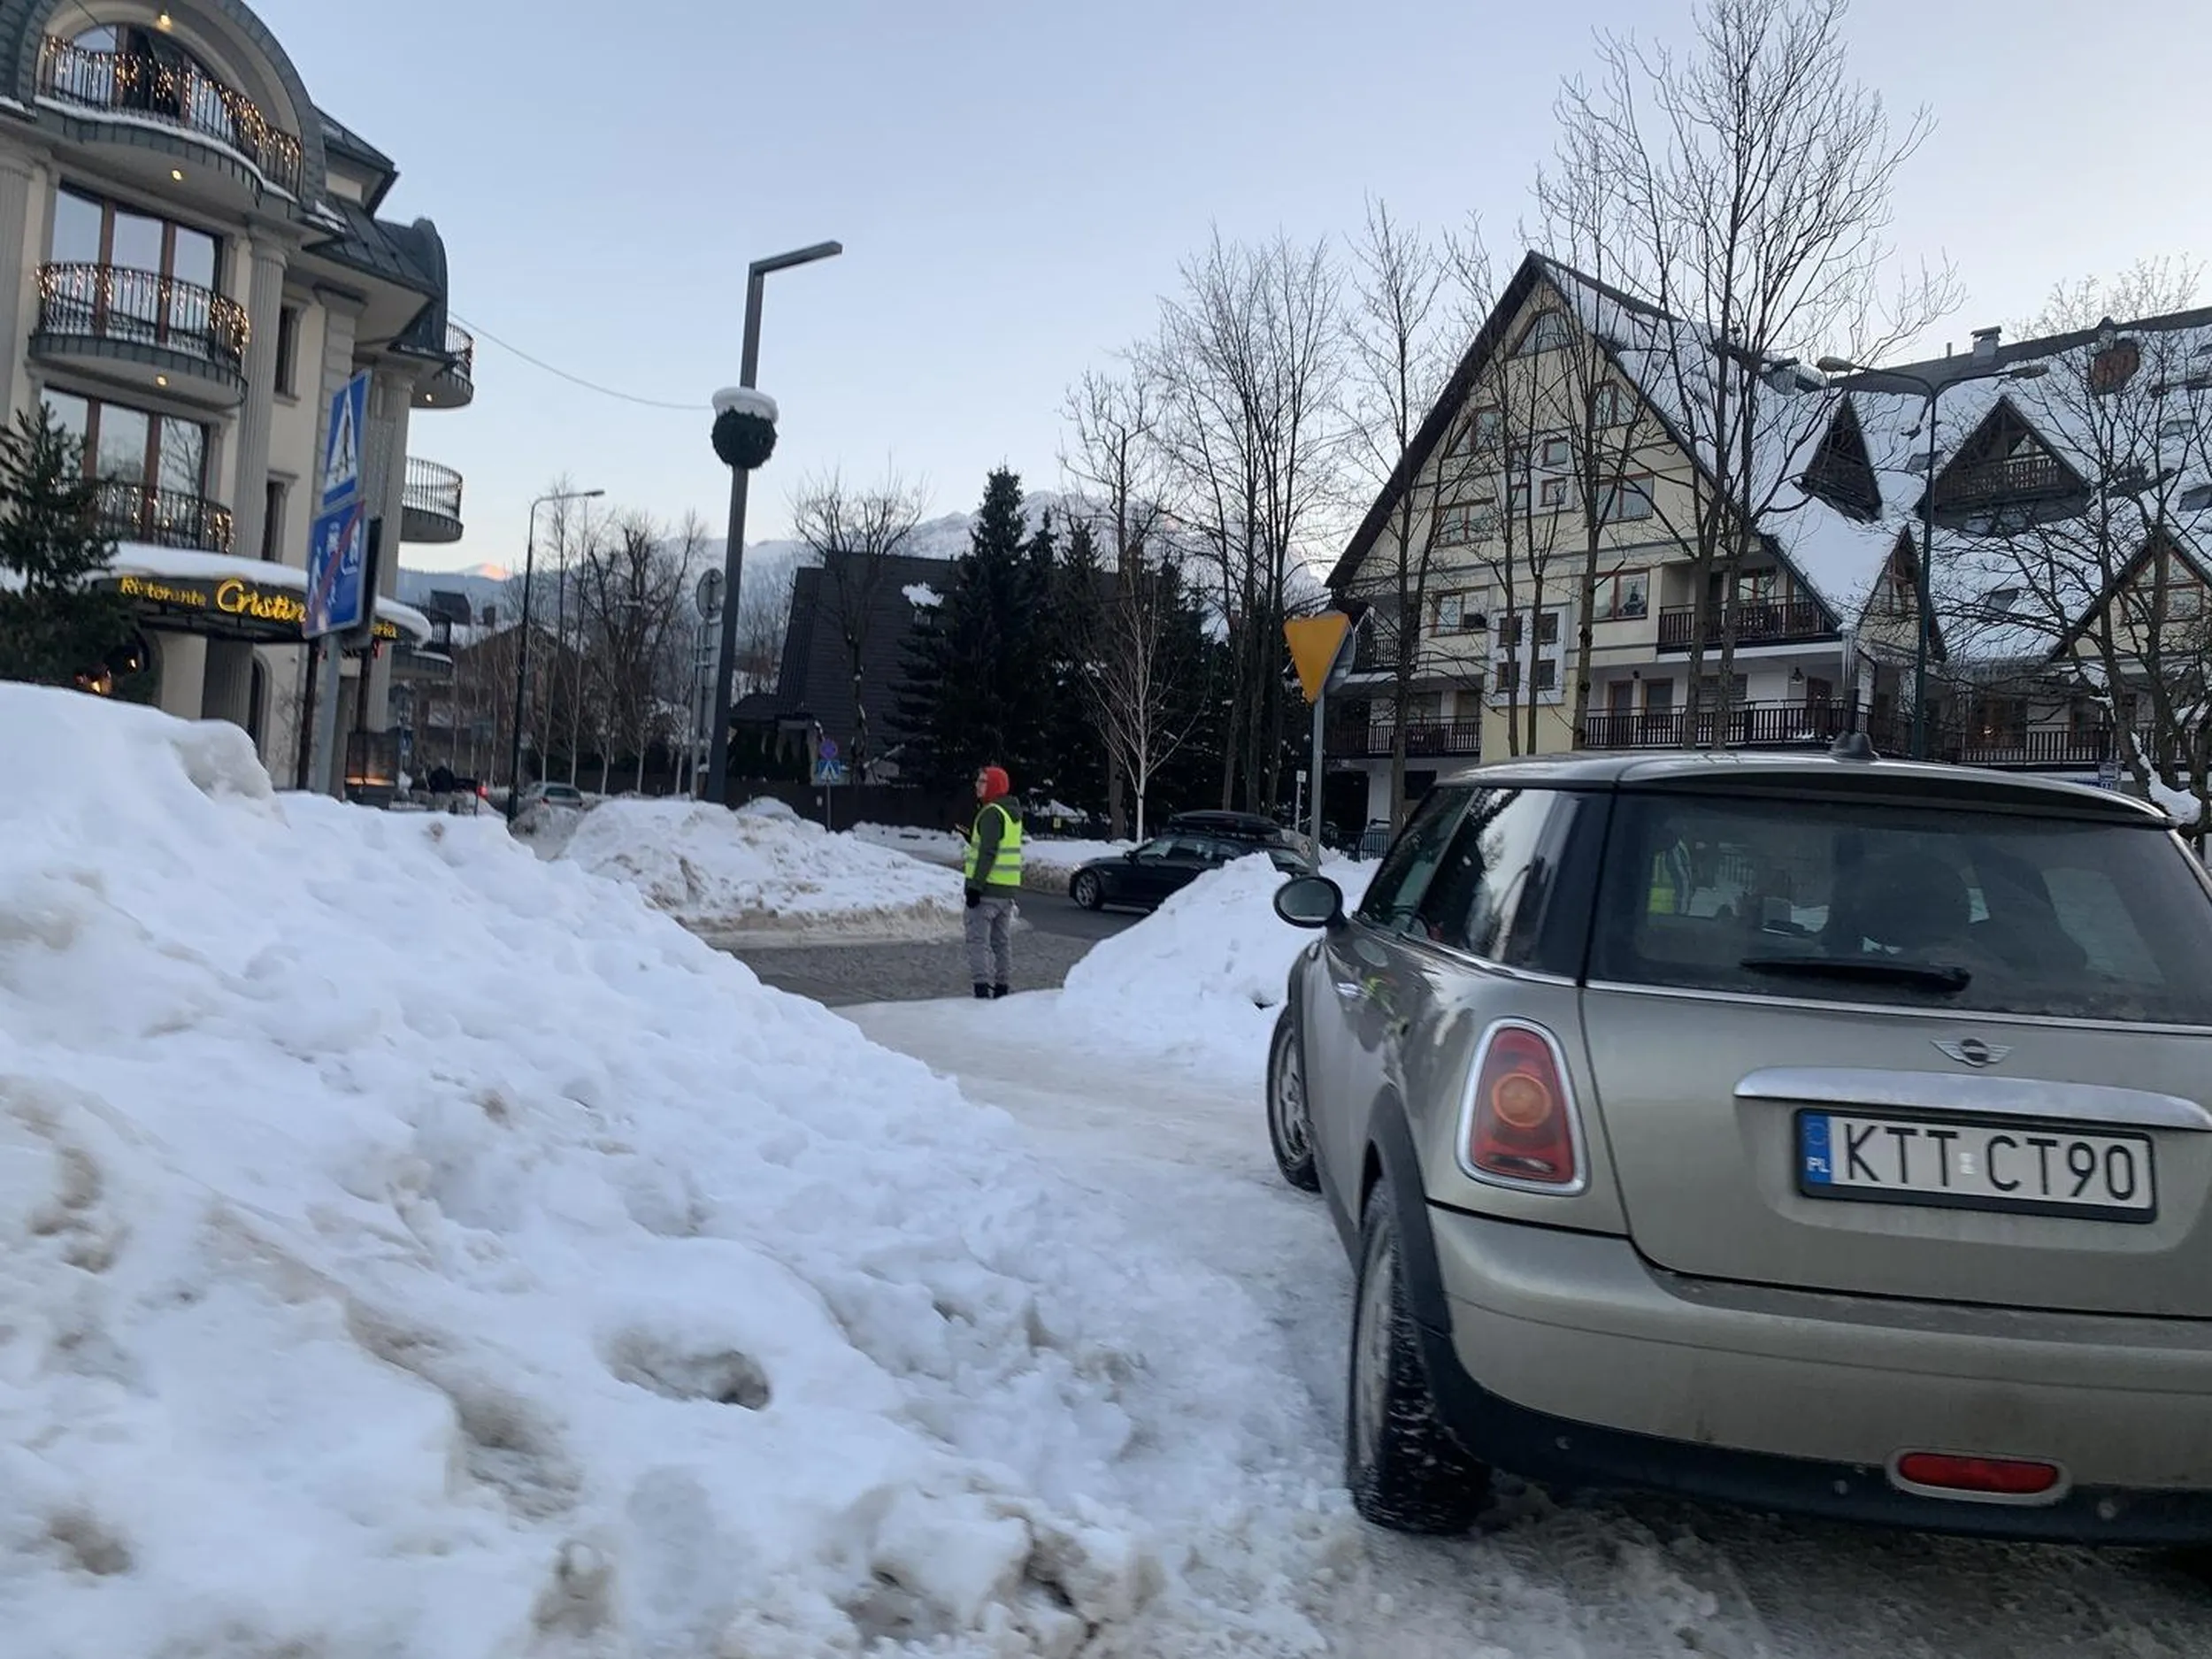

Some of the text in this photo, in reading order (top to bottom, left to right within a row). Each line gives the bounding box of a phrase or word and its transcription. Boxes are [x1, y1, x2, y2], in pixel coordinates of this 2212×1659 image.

[217, 578, 306, 622] Cristin
[1807, 1156, 1831, 1173] PL
[1845, 1123, 2135, 1201] KTT CT90
